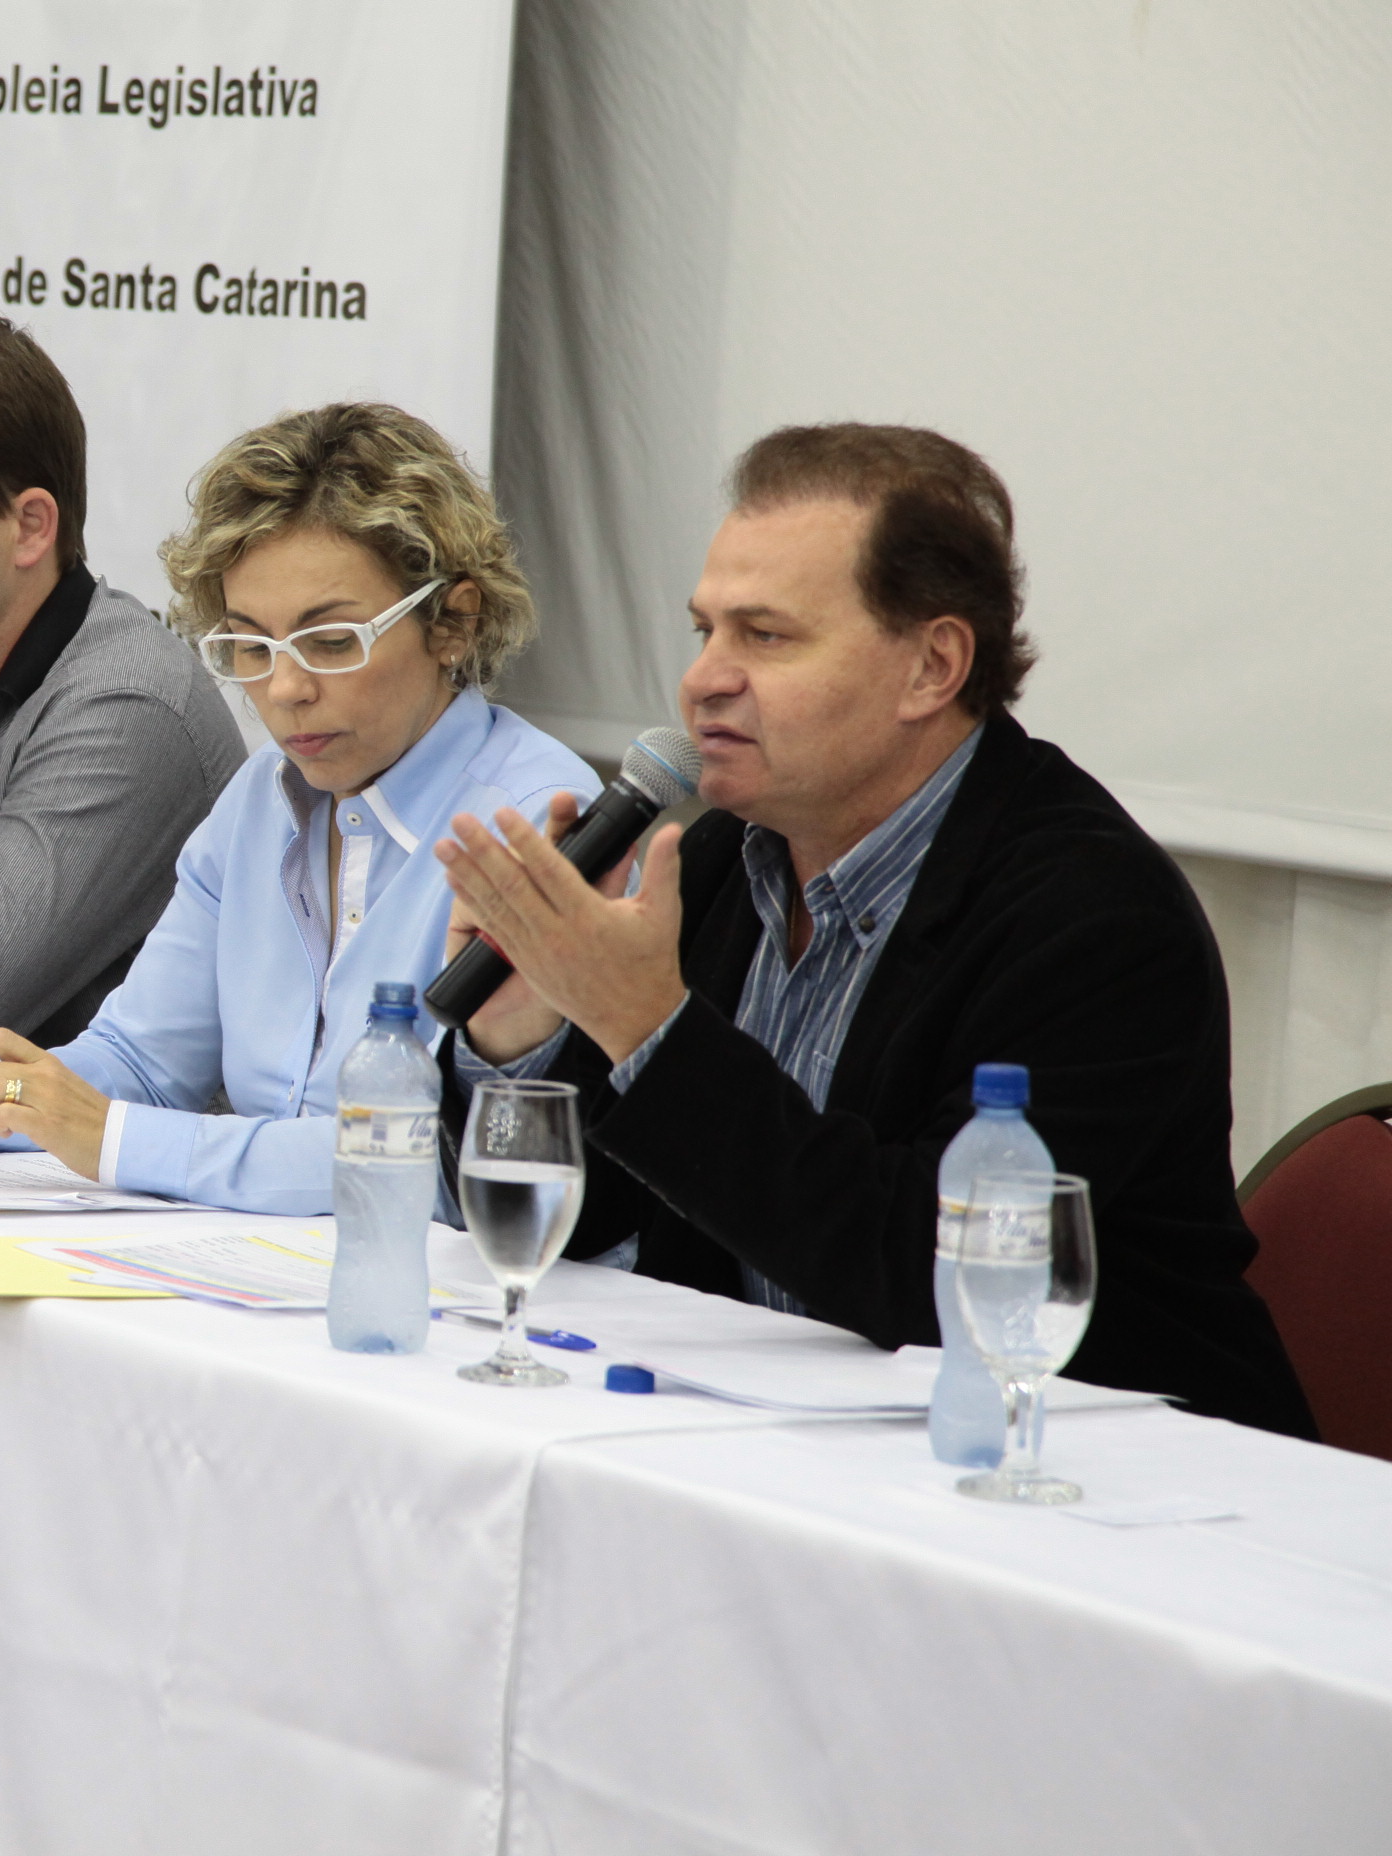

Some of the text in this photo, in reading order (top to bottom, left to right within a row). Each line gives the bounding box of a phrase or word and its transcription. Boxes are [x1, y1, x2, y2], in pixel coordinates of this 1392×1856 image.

[99, 65, 317, 129] Legislativa
[3, 257, 47, 305] de
[63, 258, 176, 311] Santa
[194, 263, 366, 320] Catarina
